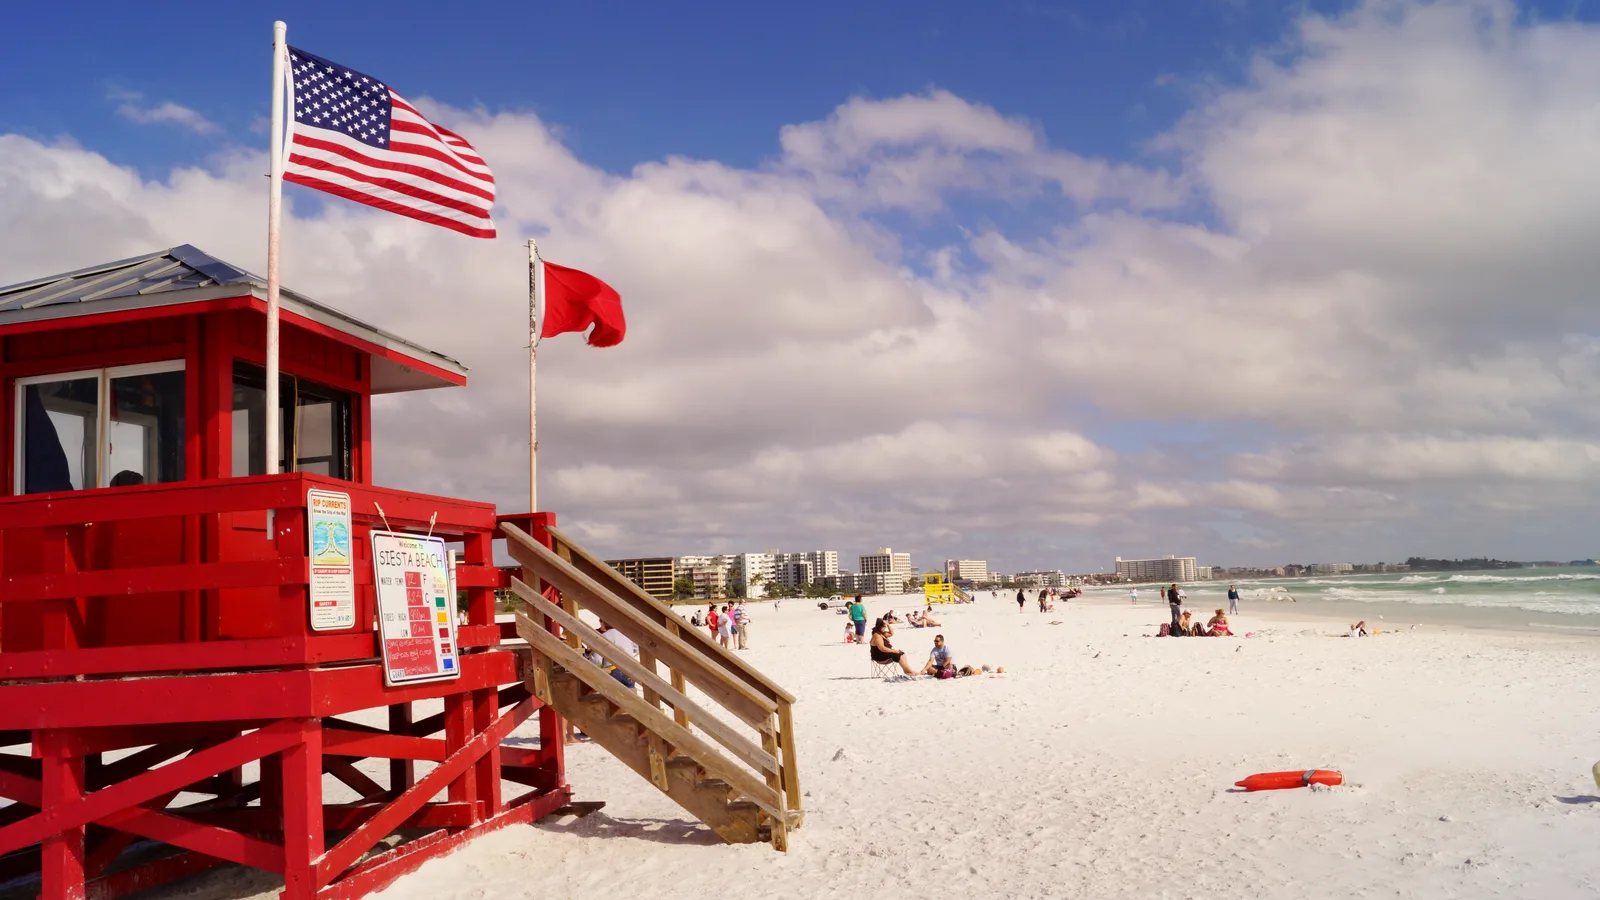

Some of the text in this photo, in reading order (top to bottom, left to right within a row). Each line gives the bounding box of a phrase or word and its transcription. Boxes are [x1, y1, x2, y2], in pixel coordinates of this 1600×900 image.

[313, 499, 346, 509] RIP CURRENTS
[399, 541, 418, 549] Welcome
[380, 550, 443, 568] SIESTA BEACH
[381, 577, 404, 586] WATER TEMP
[425, 592, 430, 604] C
[398, 612, 408, 621] HIGH
[392, 669, 405, 679] GUARD
